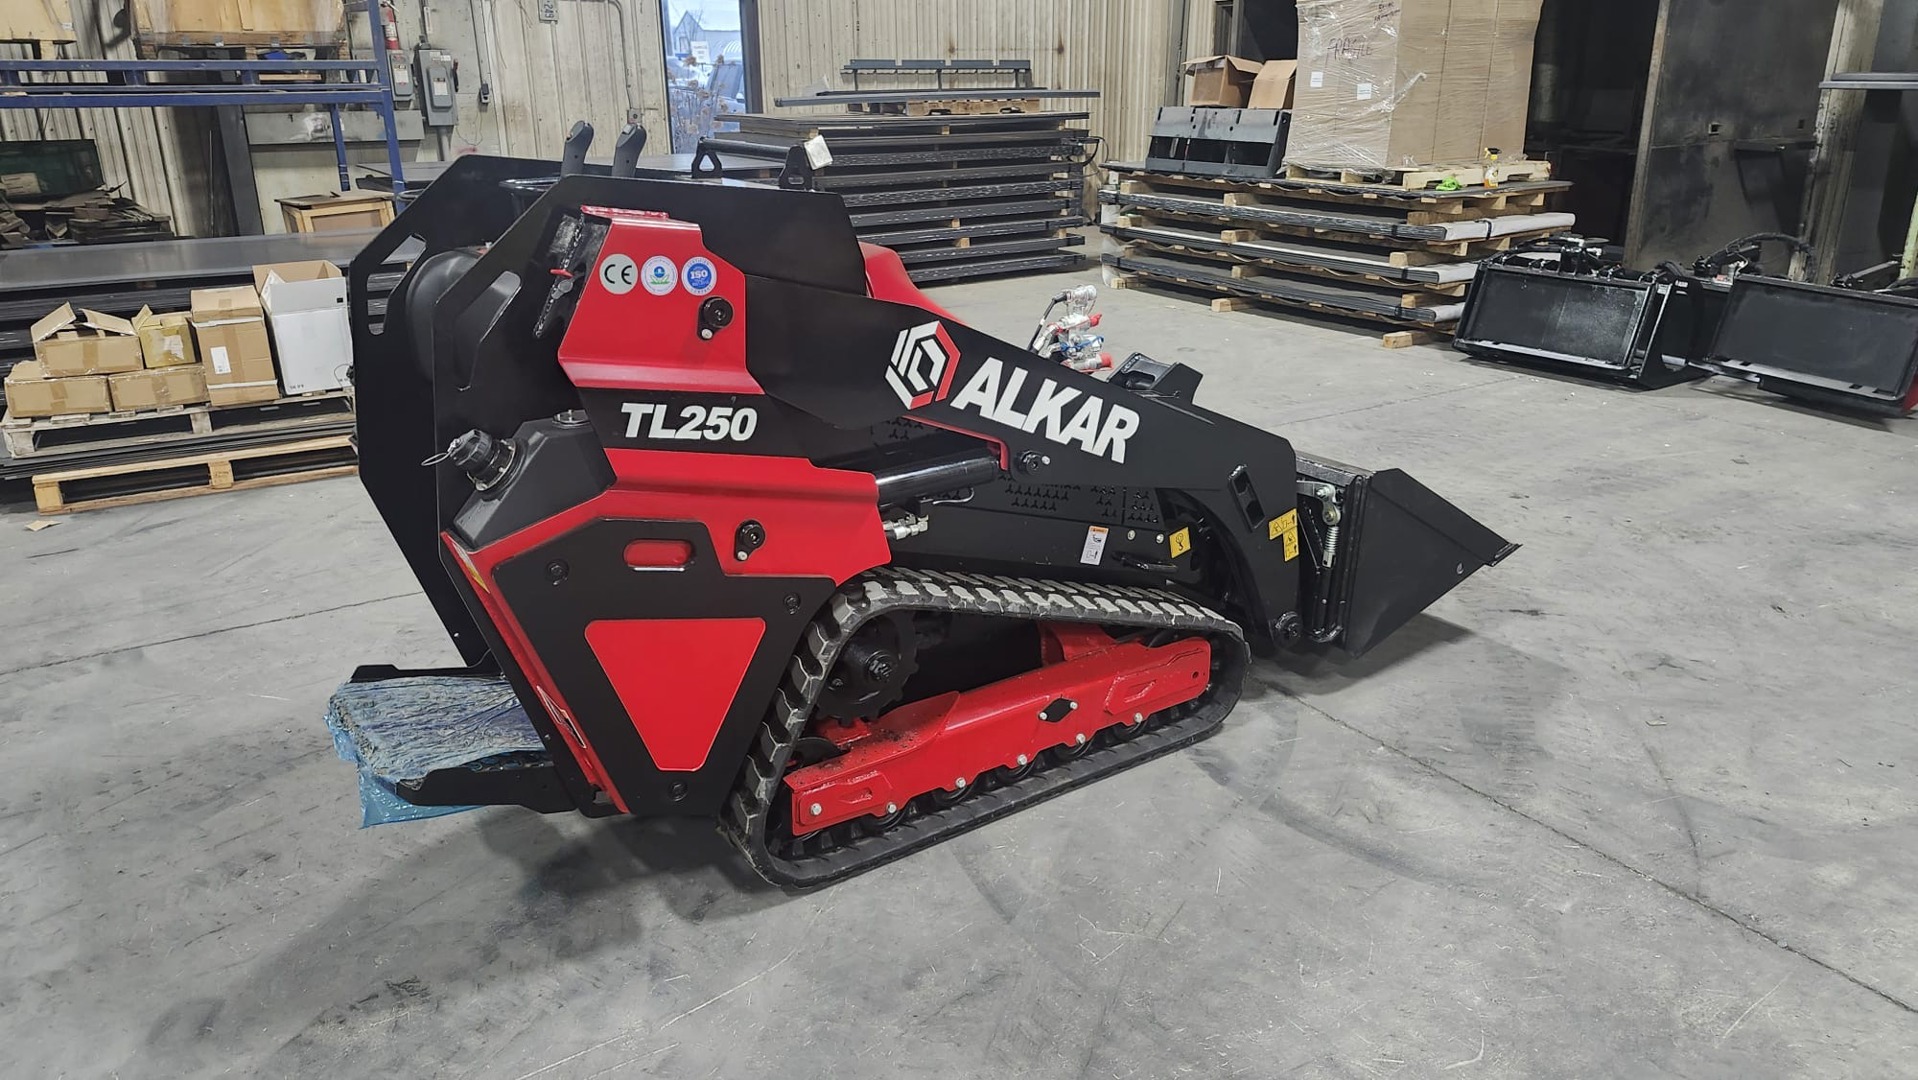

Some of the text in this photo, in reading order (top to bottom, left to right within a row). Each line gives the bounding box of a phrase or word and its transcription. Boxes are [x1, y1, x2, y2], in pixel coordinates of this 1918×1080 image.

[604, 264, 632, 285] CE
[690, 269, 708, 280] ISO
[621, 402, 758, 441] TL250
[950, 356, 1140, 464] ALKAR
